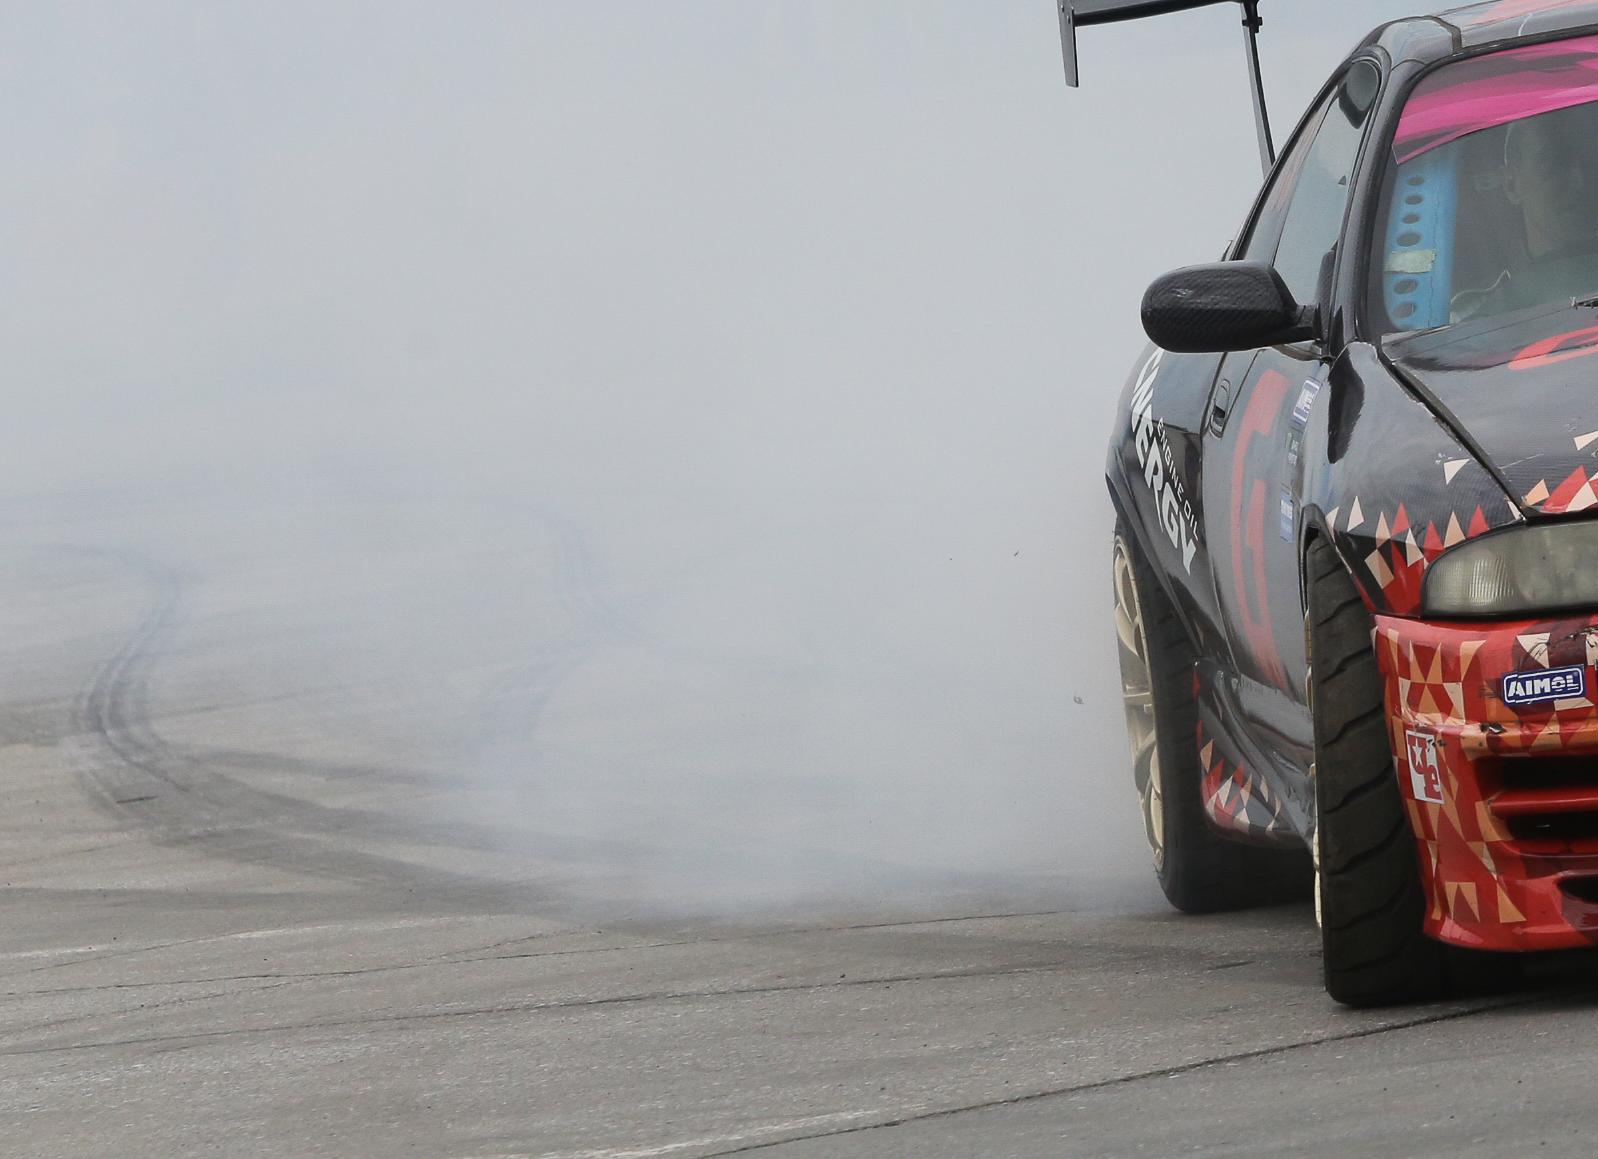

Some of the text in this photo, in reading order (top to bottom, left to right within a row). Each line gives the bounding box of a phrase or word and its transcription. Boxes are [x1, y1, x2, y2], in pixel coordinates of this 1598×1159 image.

[1157, 417, 1199, 541] ENGINE OIL
[1508, 673, 1580, 698] AIMOL
